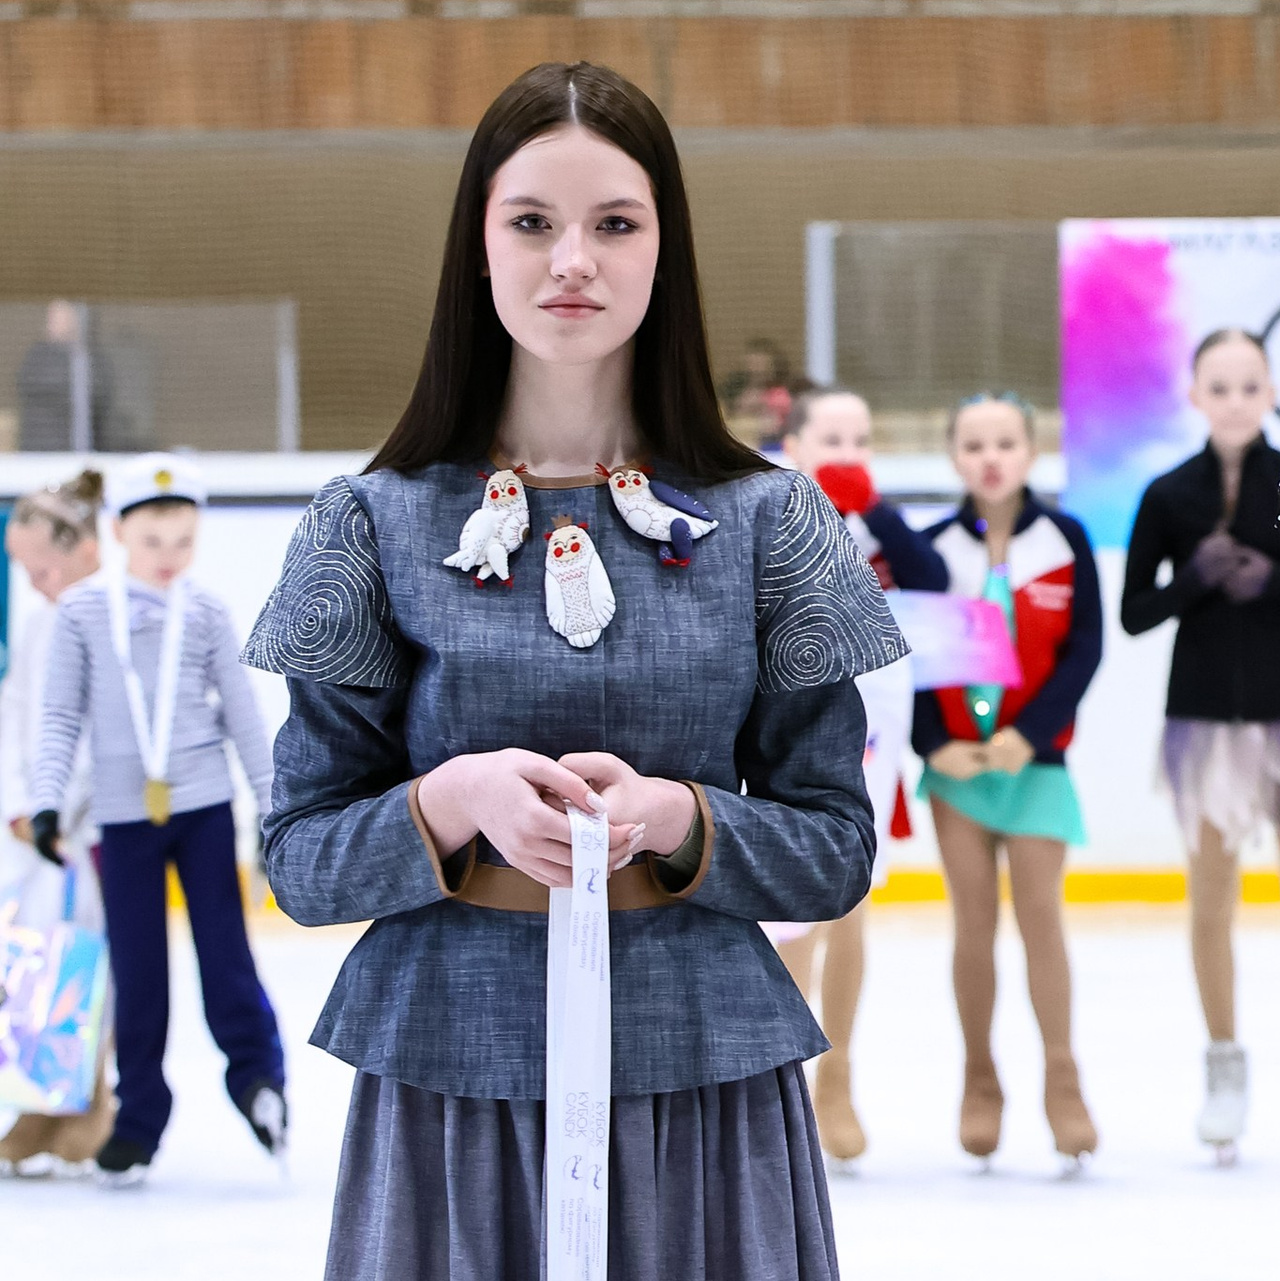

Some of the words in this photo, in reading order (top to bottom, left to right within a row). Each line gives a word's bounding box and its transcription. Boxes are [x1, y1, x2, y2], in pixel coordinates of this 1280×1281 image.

[565, 1093, 577, 1139] CANDY
[576, 1092, 589, 1138] КУБОК
[596, 1102, 607, 1148] КУБОК
